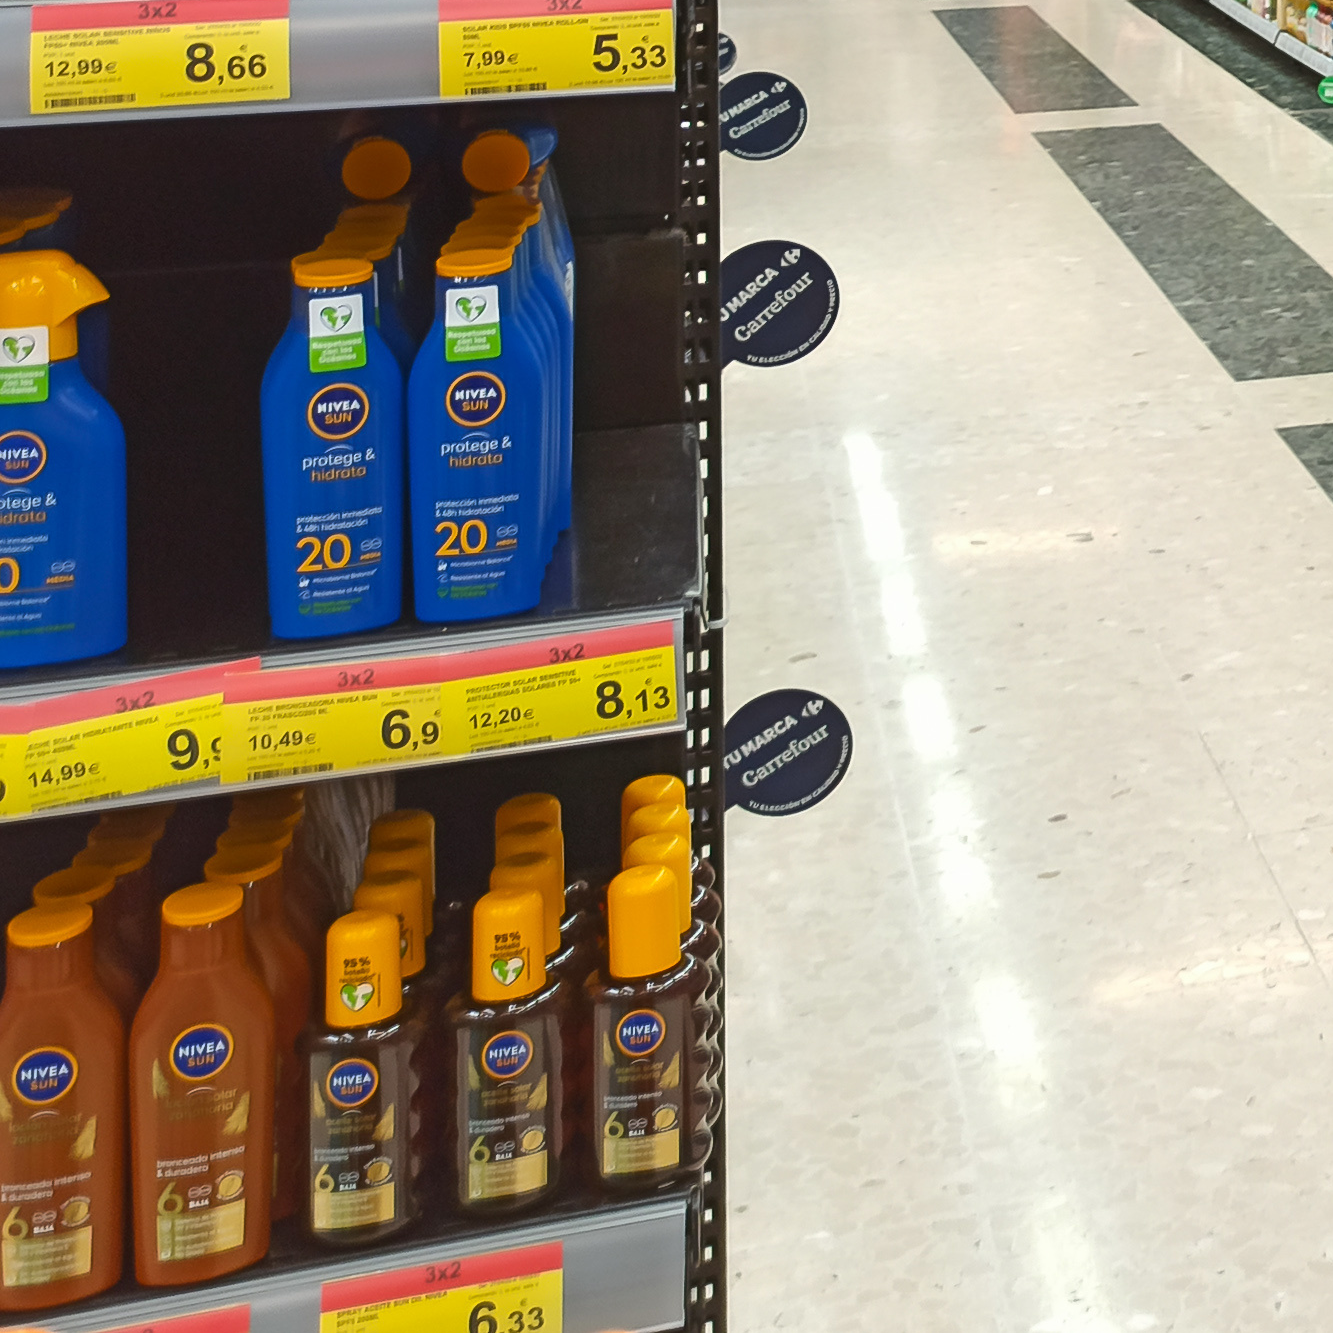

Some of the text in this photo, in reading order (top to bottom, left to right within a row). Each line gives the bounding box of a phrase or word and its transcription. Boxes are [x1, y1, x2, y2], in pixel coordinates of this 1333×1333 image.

[138, 1, 178, 20] 3x2
[728, 267, 779, 315] MARCA
[734, 272, 813, 342] Carrefour
[454, 388, 498, 403] NIVEA
[462, 398, 489, 412] SUN
[317, 399, 360, 414] NIVEA
[325, 410, 353, 425] SUN
[302, 448, 375, 470] protege &
[311, 464, 366, 481] hidrata
[435, 520, 488, 556] 20
[296, 534, 351, 572] 20
[550, 643, 585, 664] 3x2
[338, 668, 375, 687] 3x2
[742, 715, 798, 757] MARCA
[742, 725, 830, 787] Carrefour
[177, 1039, 226, 1059] NIVEA
[187, 1053, 216, 1068] SUN
[20, 1063, 70, 1082] NIVEA
[332, 1072, 373, 1088] NIVEA
[30, 1077, 59, 1090] SUN
[340, 1085, 363, 1095] SUN
[426, 1261, 461, 1282] 3x2
